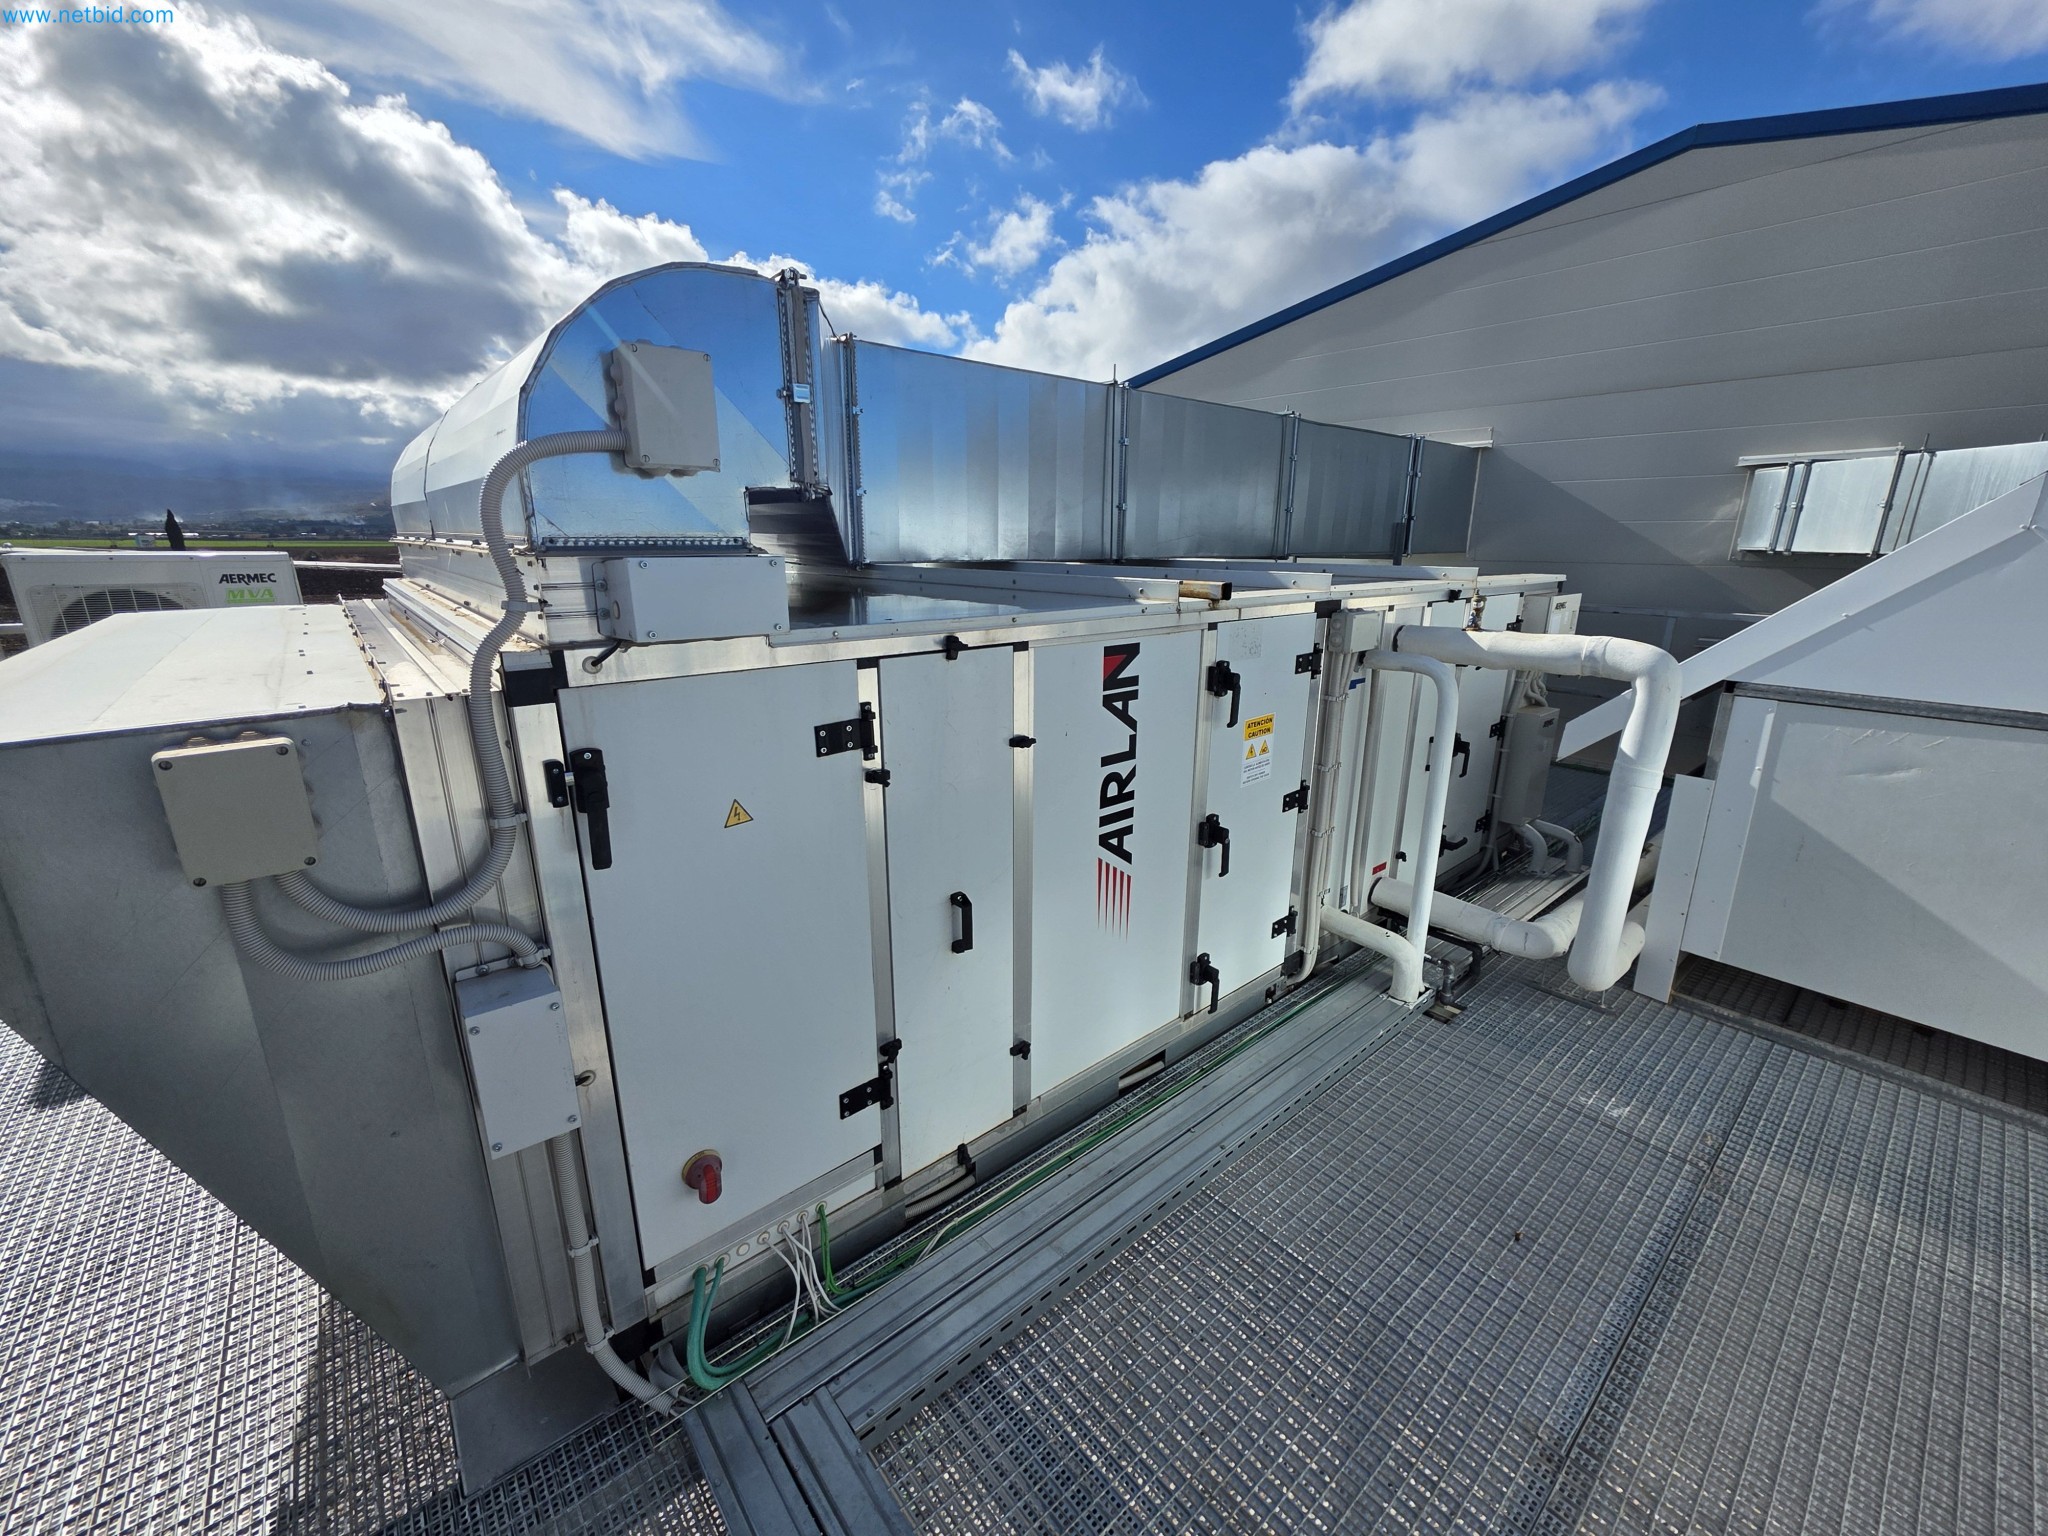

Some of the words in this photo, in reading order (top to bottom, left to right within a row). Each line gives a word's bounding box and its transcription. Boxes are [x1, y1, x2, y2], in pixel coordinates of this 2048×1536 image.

[219, 573, 277, 585] AERMEC
[226, 588, 275, 601] MVA
[1247, 717, 1273, 728] ATENCIÓN
[1247, 727, 1271, 738] CAUTION
[1099, 642, 1141, 865] AIRLAN
